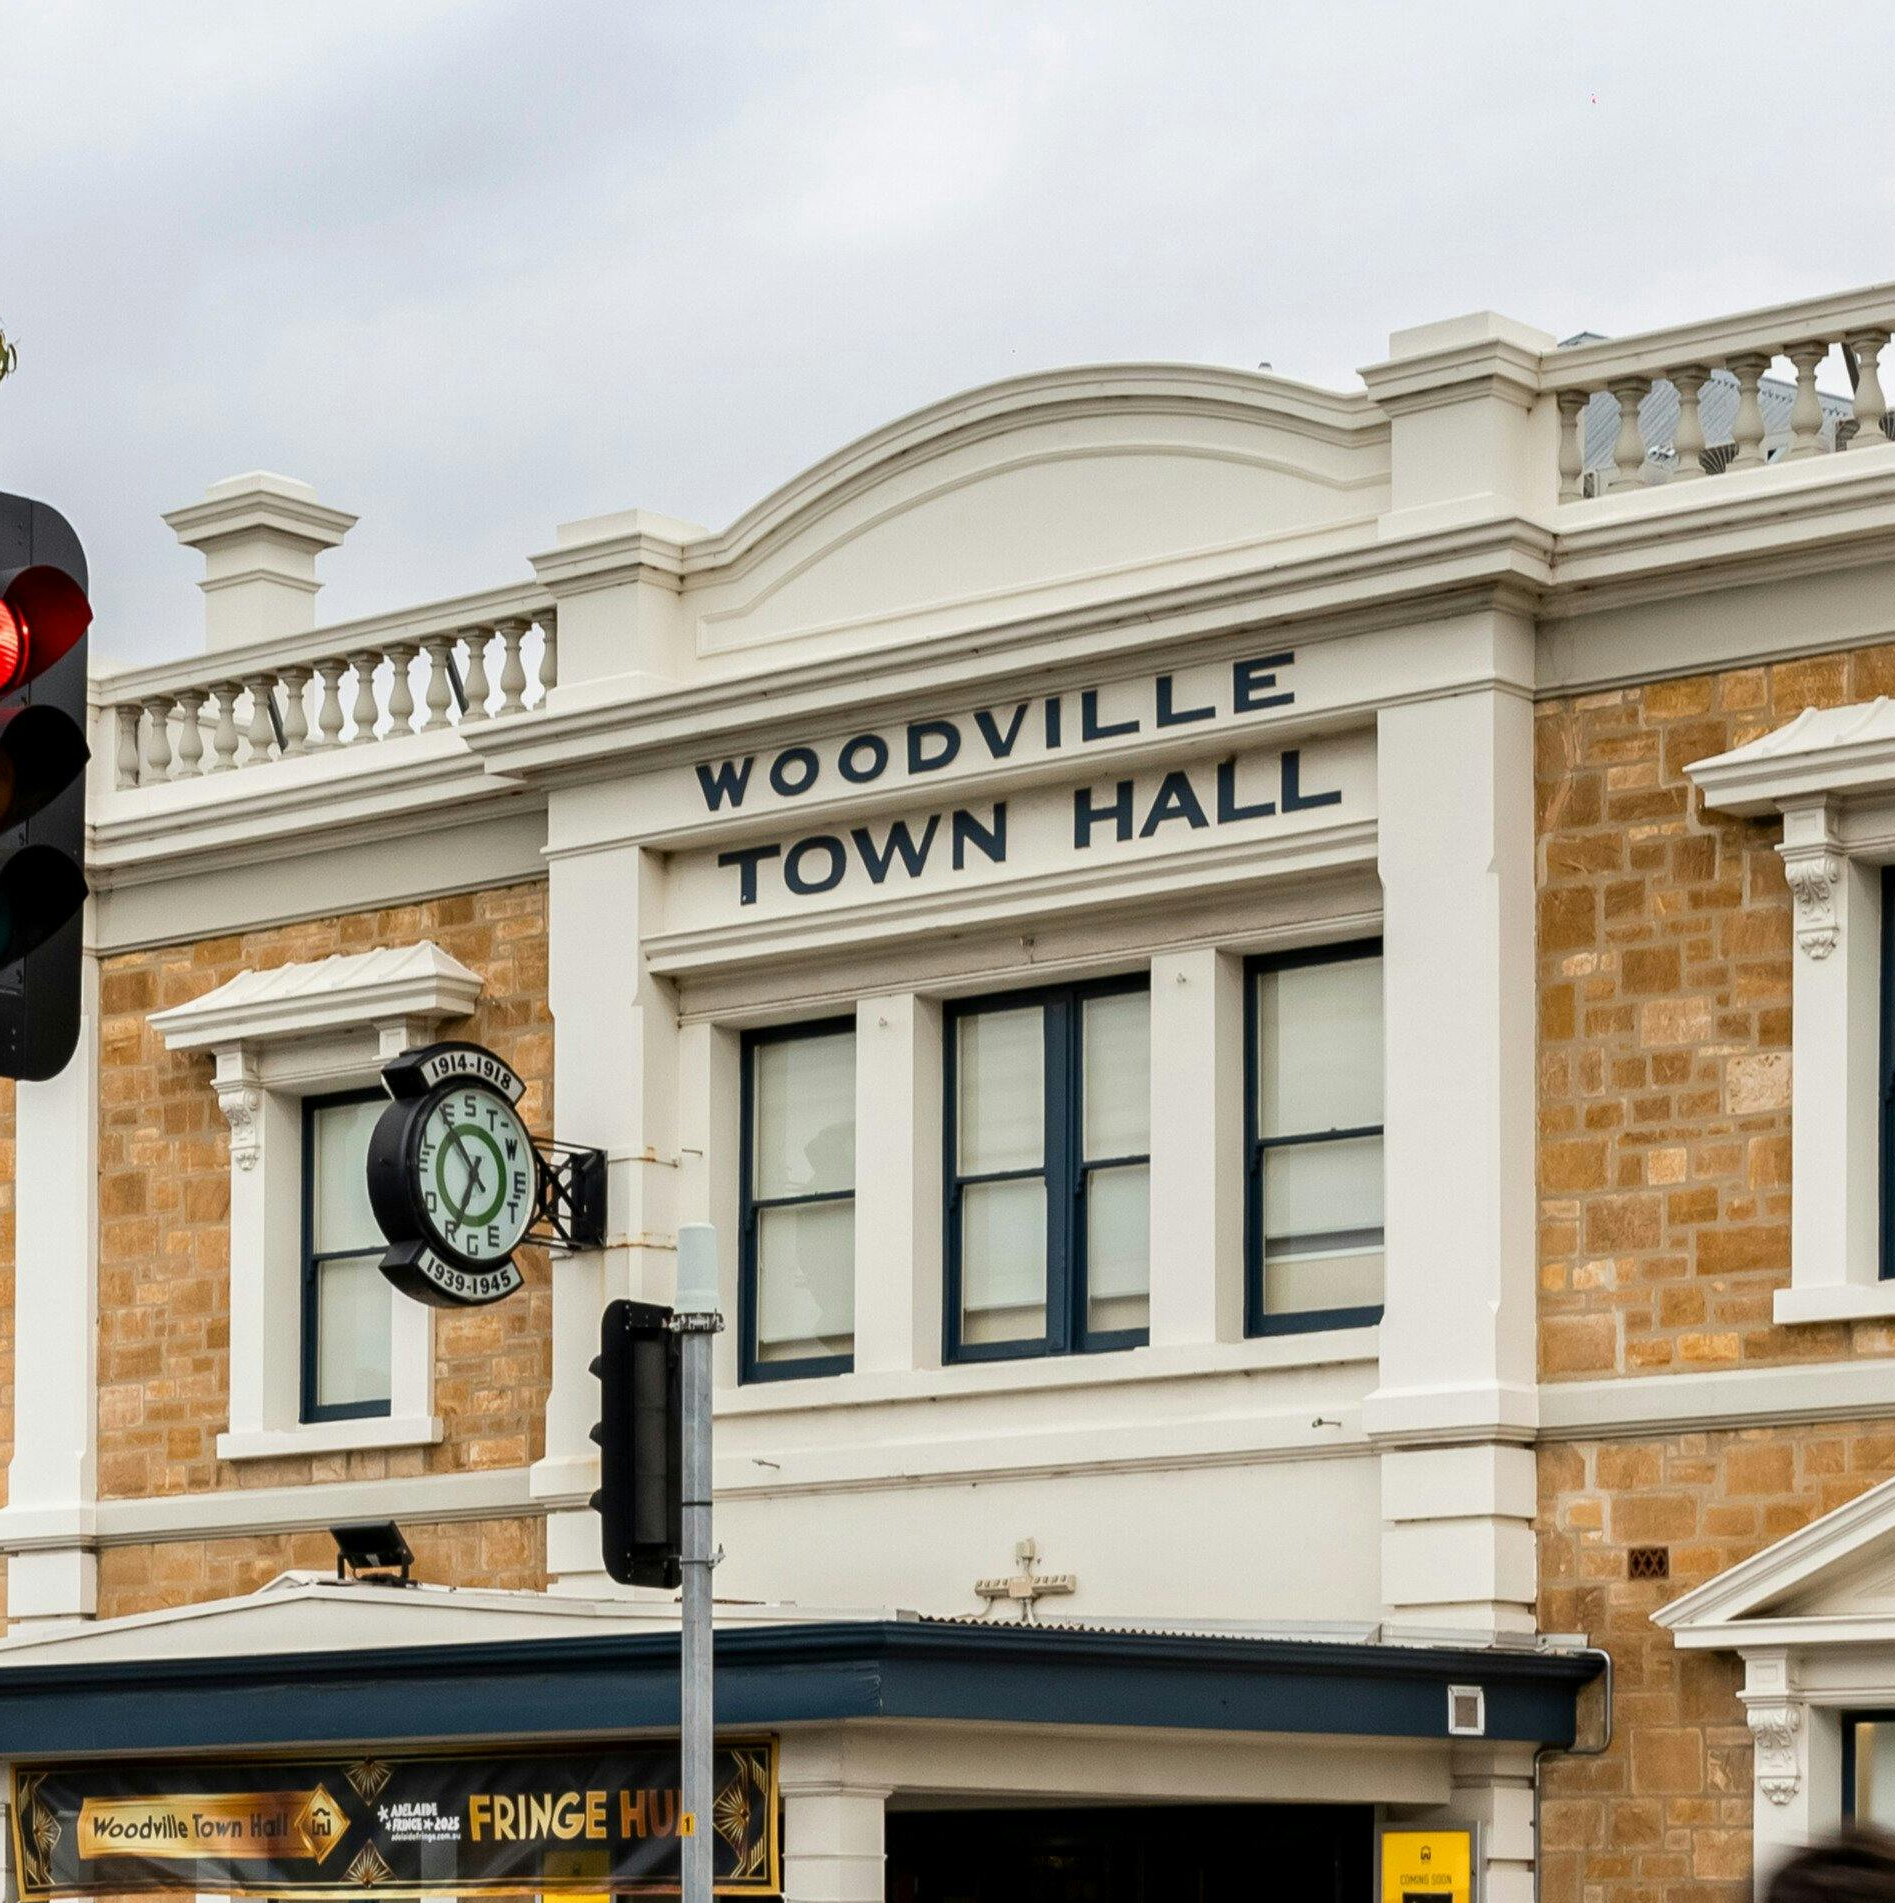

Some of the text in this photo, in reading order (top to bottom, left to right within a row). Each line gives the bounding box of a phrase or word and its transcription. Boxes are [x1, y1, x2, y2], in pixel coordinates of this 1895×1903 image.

[696, 652, 1297, 812] WOODVILLE
[718, 751, 1342, 906] TOWN HALL
[431, 1053, 513, 1091] 1914-1918
[426, 1256, 513, 1295] 1939-1945
[390, 1802, 438, 1817] ADELAIDE
[392, 1816, 460, 1831] FRINGE 2025
[469, 1789, 683, 1842] FRINGE HU
[685, 1816, 691, 1832] 1
[93, 1813, 288, 1839] Woodville Town Hall
[1400, 1874, 1452, 1885] COMING SOON
